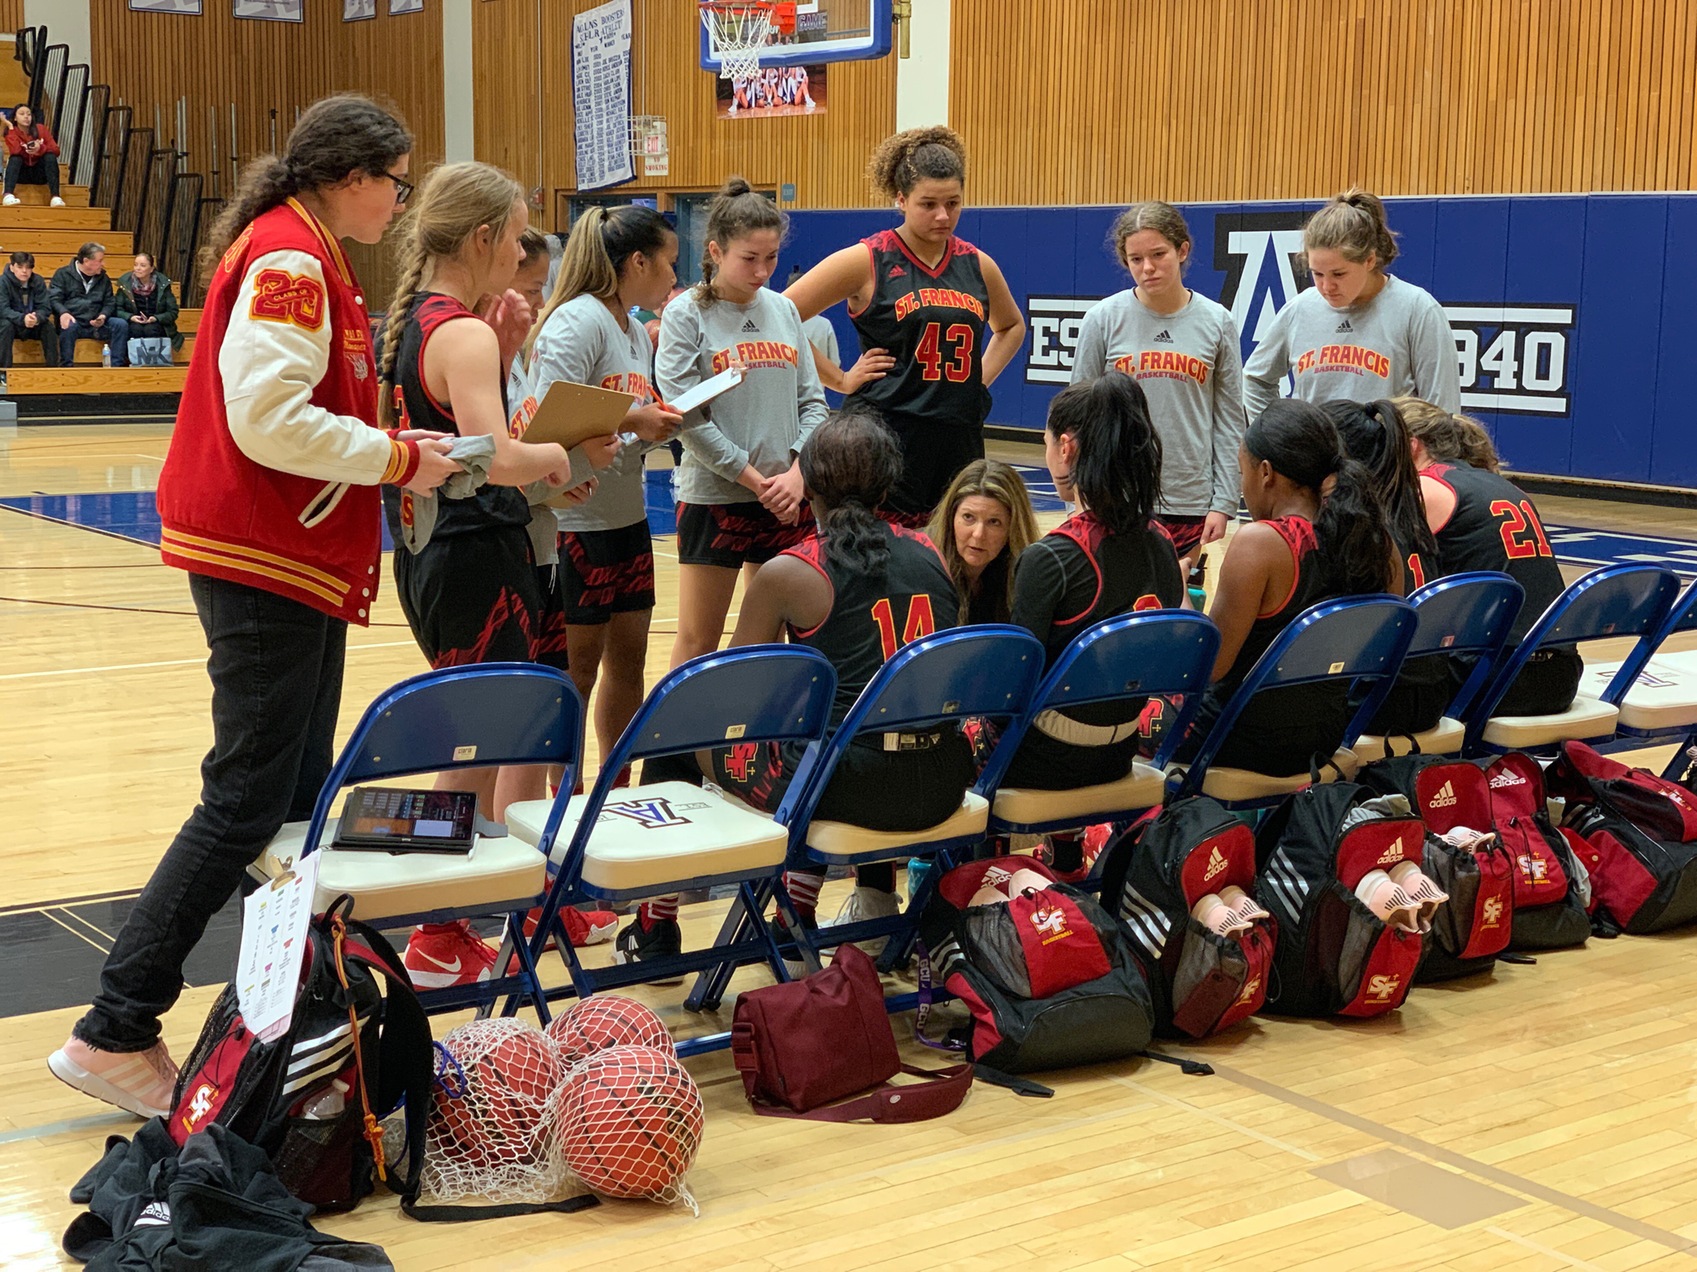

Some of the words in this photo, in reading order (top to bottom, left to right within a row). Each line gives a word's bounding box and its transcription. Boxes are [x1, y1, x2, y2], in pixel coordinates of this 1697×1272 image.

[797, 12, 828, 32] GAME
[249, 268, 326, 333] 20
[273, 292, 297, 301] CLASS
[894, 292, 920, 322] ST.
[915, 322, 974, 383] 43
[1297, 349, 1317, 377] ST.
[1317, 343, 1391, 379] FRANCIS
[744, 361, 787, 370] SKETBALL
[1136, 371, 1188, 383] BASKETBALL
[1139, 349, 1209, 386] FRANCIS
[1314, 365, 1365, 377] BASKETBALL
[1489, 499, 1554, 560] 21
[871, 593, 936, 663] 14
[1429, 797, 1457, 808] adidas
[1203, 859, 1229, 882] adidas
[1376, 854, 1404, 865] adidas
[918, 958, 931, 982] GCU
[1367, 974, 1400, 1000] SF
[916, 1002, 930, 1030] GCU
